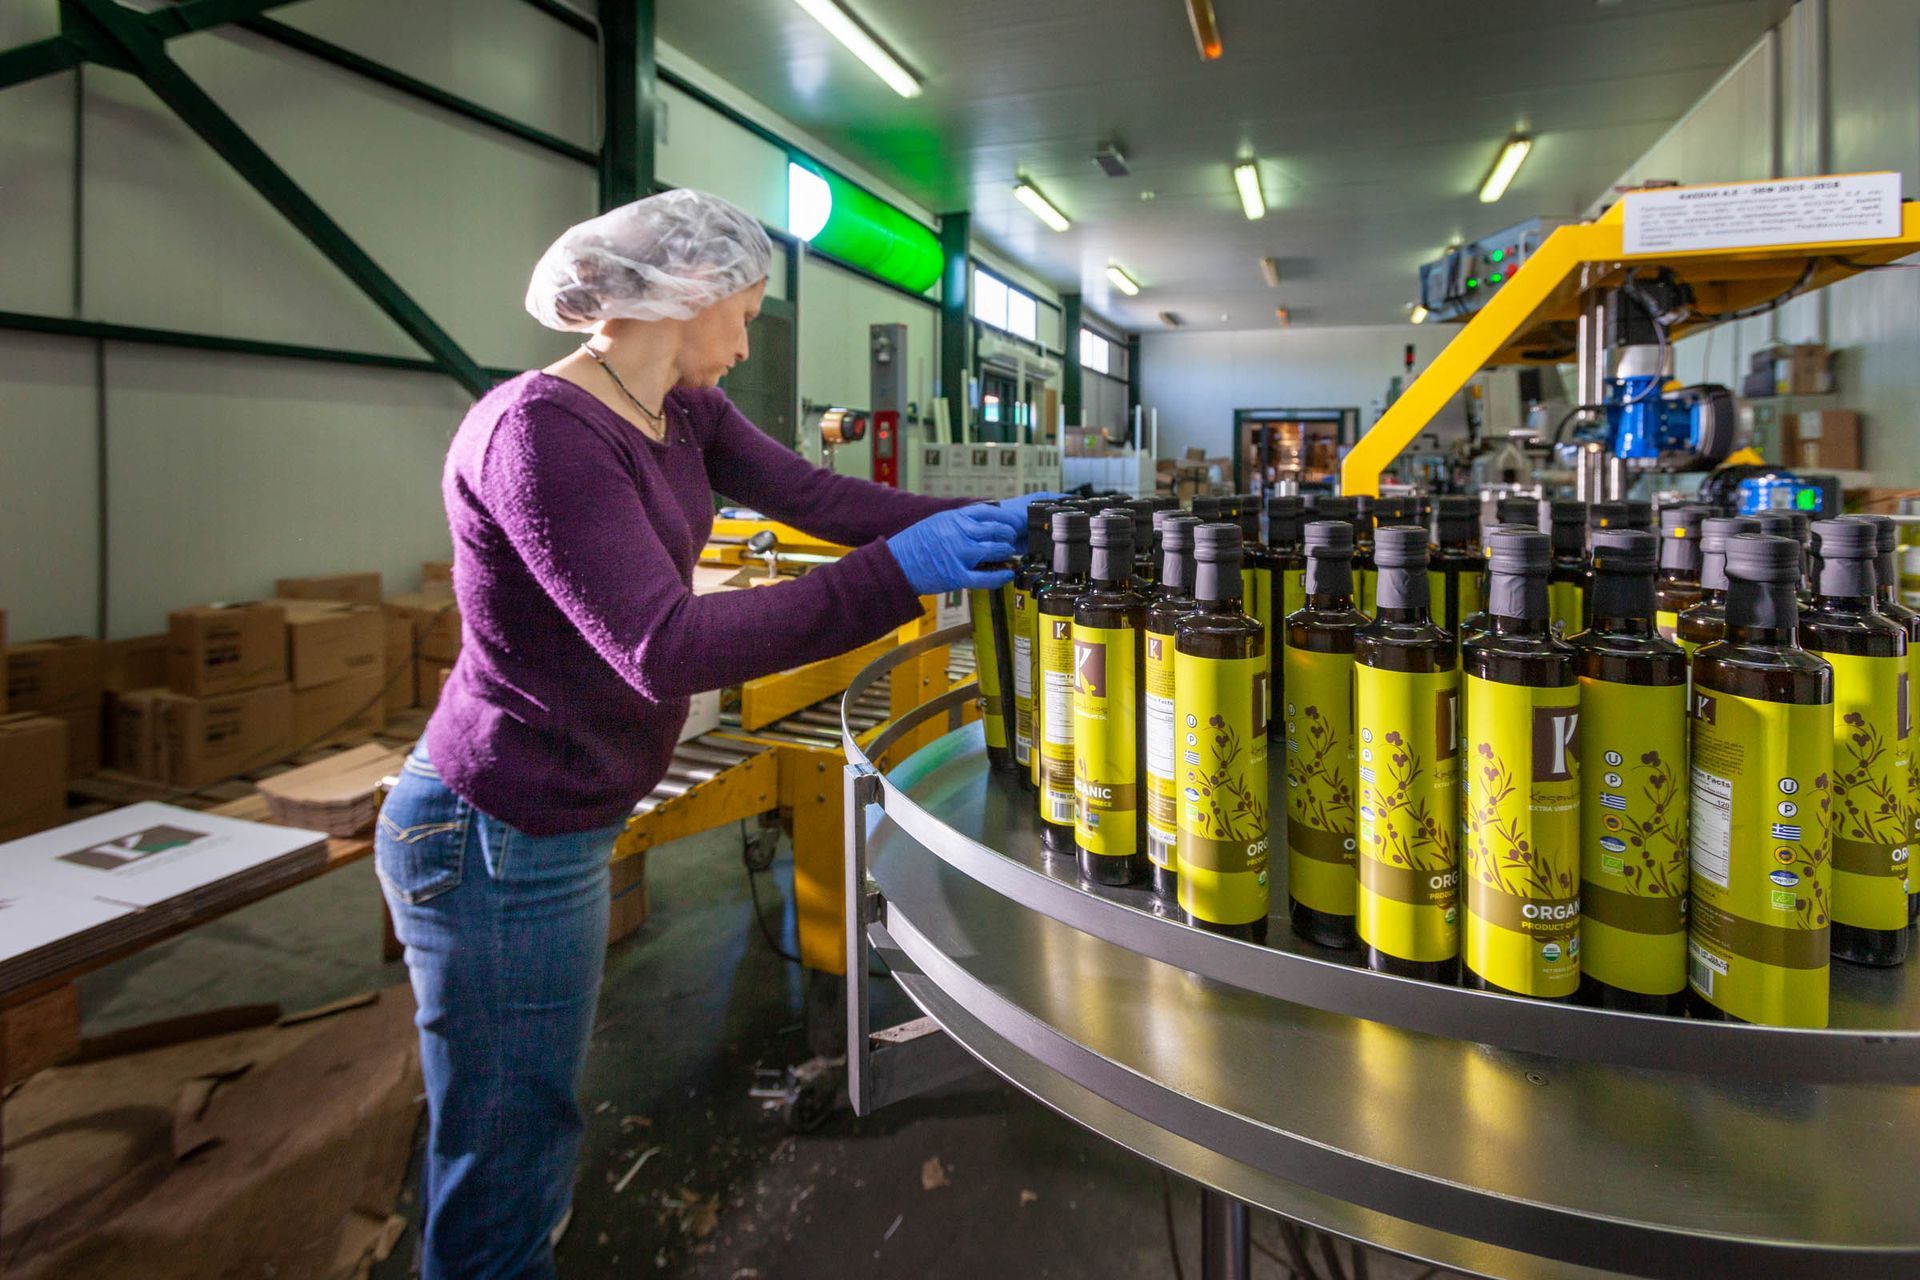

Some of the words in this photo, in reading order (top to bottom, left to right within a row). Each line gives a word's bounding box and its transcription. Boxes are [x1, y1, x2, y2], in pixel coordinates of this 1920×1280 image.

[1056, 622, 1068, 640] K
[1150, 640, 1160, 659] K
[1074, 645, 1097, 696] K
[1697, 695, 1711, 722] K
[1552, 714, 1579, 778] K
[1707, 775, 1731, 788] Facts
[1718, 800, 1730, 809] 120
[1247, 837, 1268, 856] ORG
[1344, 838, 1356, 850] O
[1430, 871, 1458, 889] ORG
[1522, 899, 1580, 919] ORGAN
[1521, 921, 1564, 931] PRODUCT
